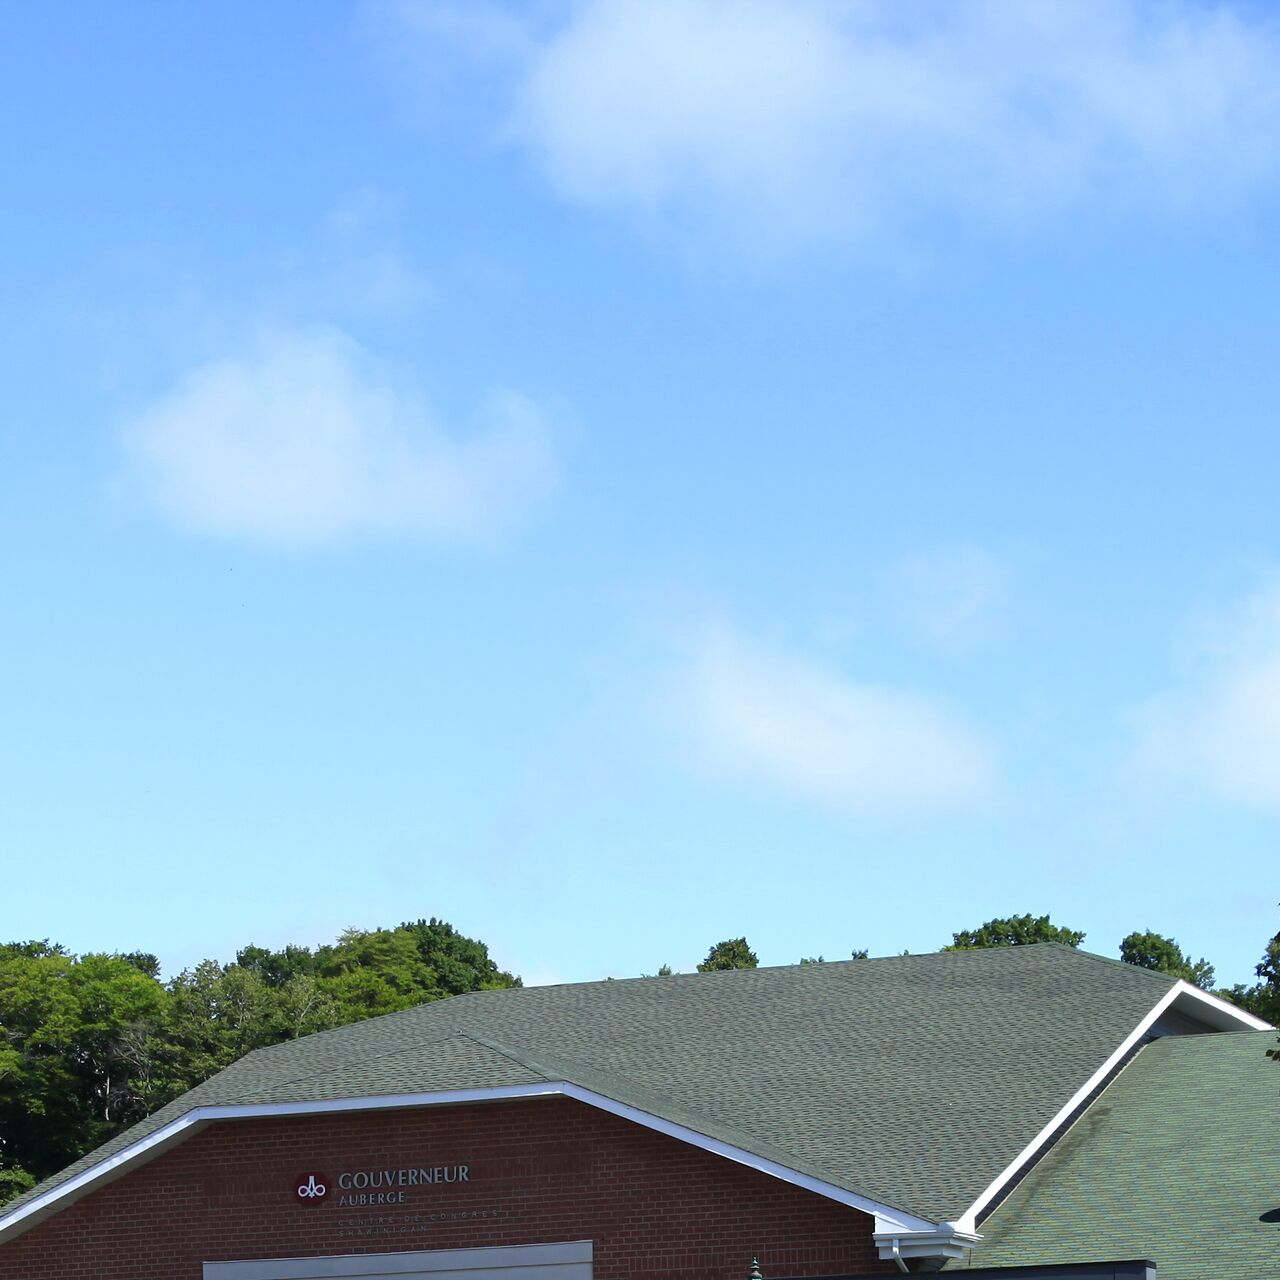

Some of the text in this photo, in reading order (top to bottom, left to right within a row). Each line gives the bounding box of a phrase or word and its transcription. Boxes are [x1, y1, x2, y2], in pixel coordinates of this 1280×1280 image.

[338, 1165, 470, 1190] GOUVERNEUR
[339, 1191, 405, 1207] AUBERGE
[338, 1215, 394, 1226] CENTRE
[405, 1214, 420, 1222] DE
